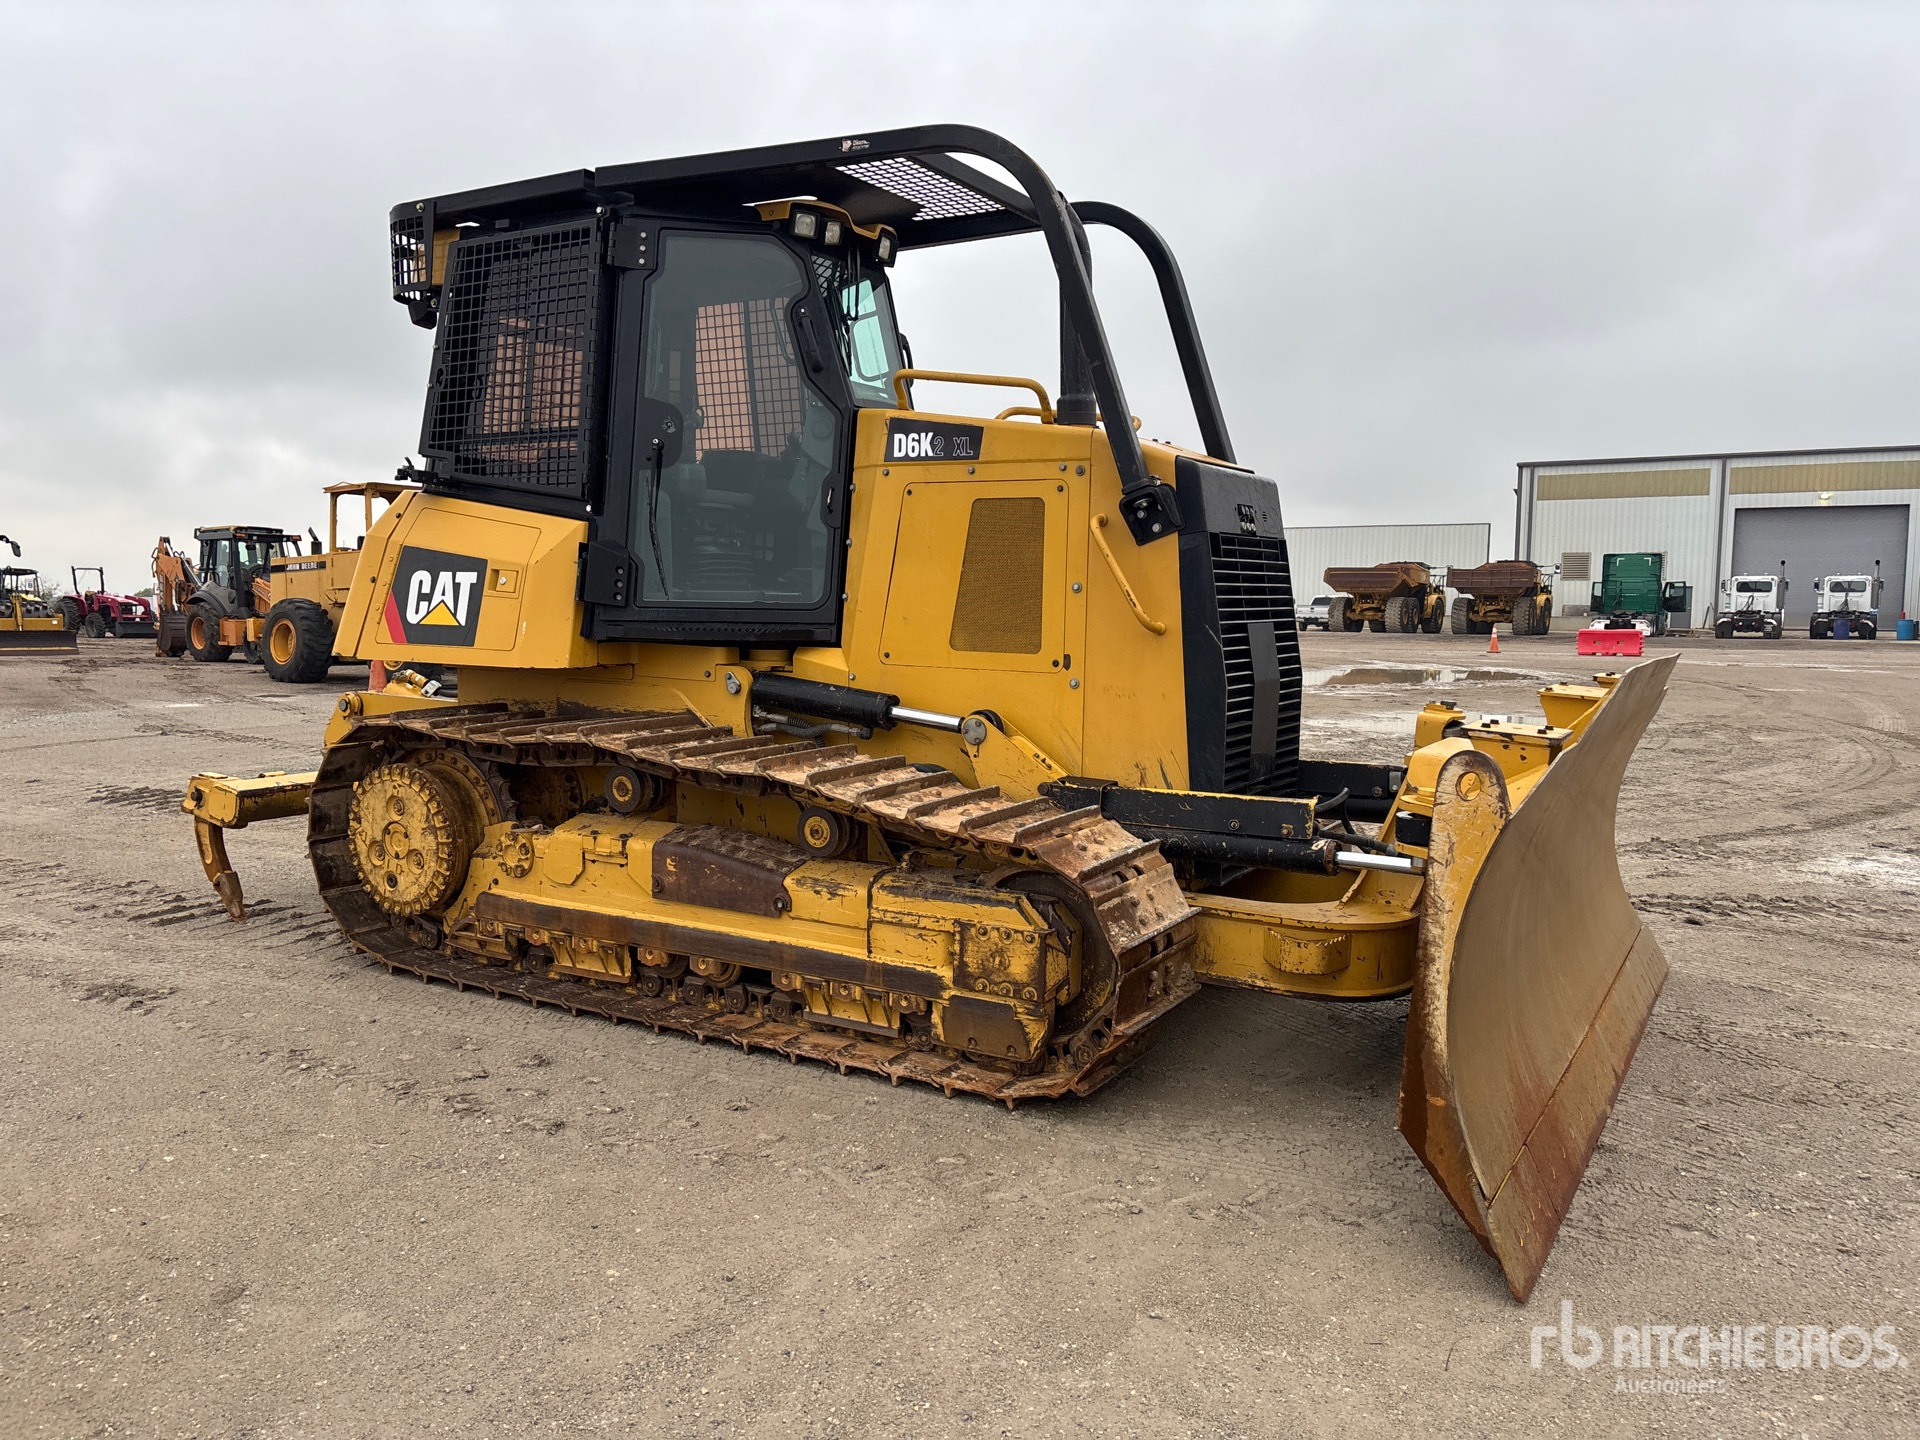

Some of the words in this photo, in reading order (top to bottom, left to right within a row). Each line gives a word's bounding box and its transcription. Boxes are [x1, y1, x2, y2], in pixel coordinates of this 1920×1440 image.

[952, 436, 974, 456] XL
[286, 563, 300, 571] JOHN
[301, 561, 318, 569] DEERE
[406, 570, 478, 626] CAT
